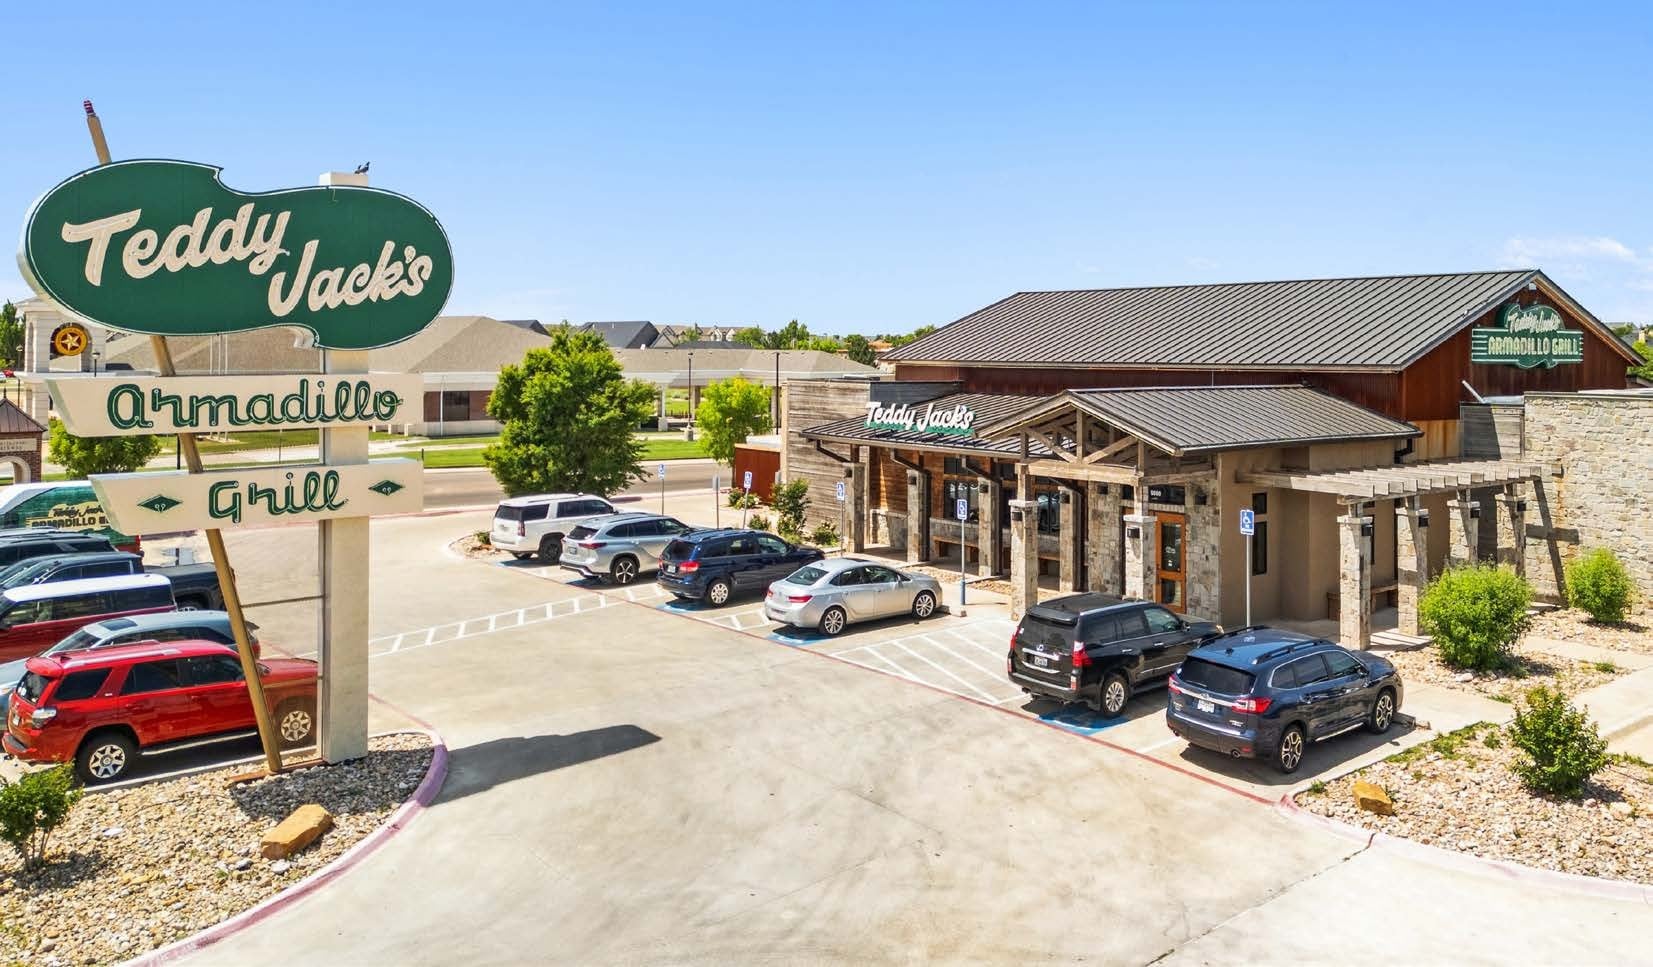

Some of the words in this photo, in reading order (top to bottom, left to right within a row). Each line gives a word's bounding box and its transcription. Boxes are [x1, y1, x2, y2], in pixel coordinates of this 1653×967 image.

[62, 203, 291, 286] Teddy
[268, 240, 433, 317] Jack's
[1488, 336, 1549, 355] ARMADILLO
[1552, 338, 1579, 355] GRILL
[865, 402, 915, 430] Teddy
[917, 403, 974, 431] Jack's
[208, 469, 348, 523] Grill
